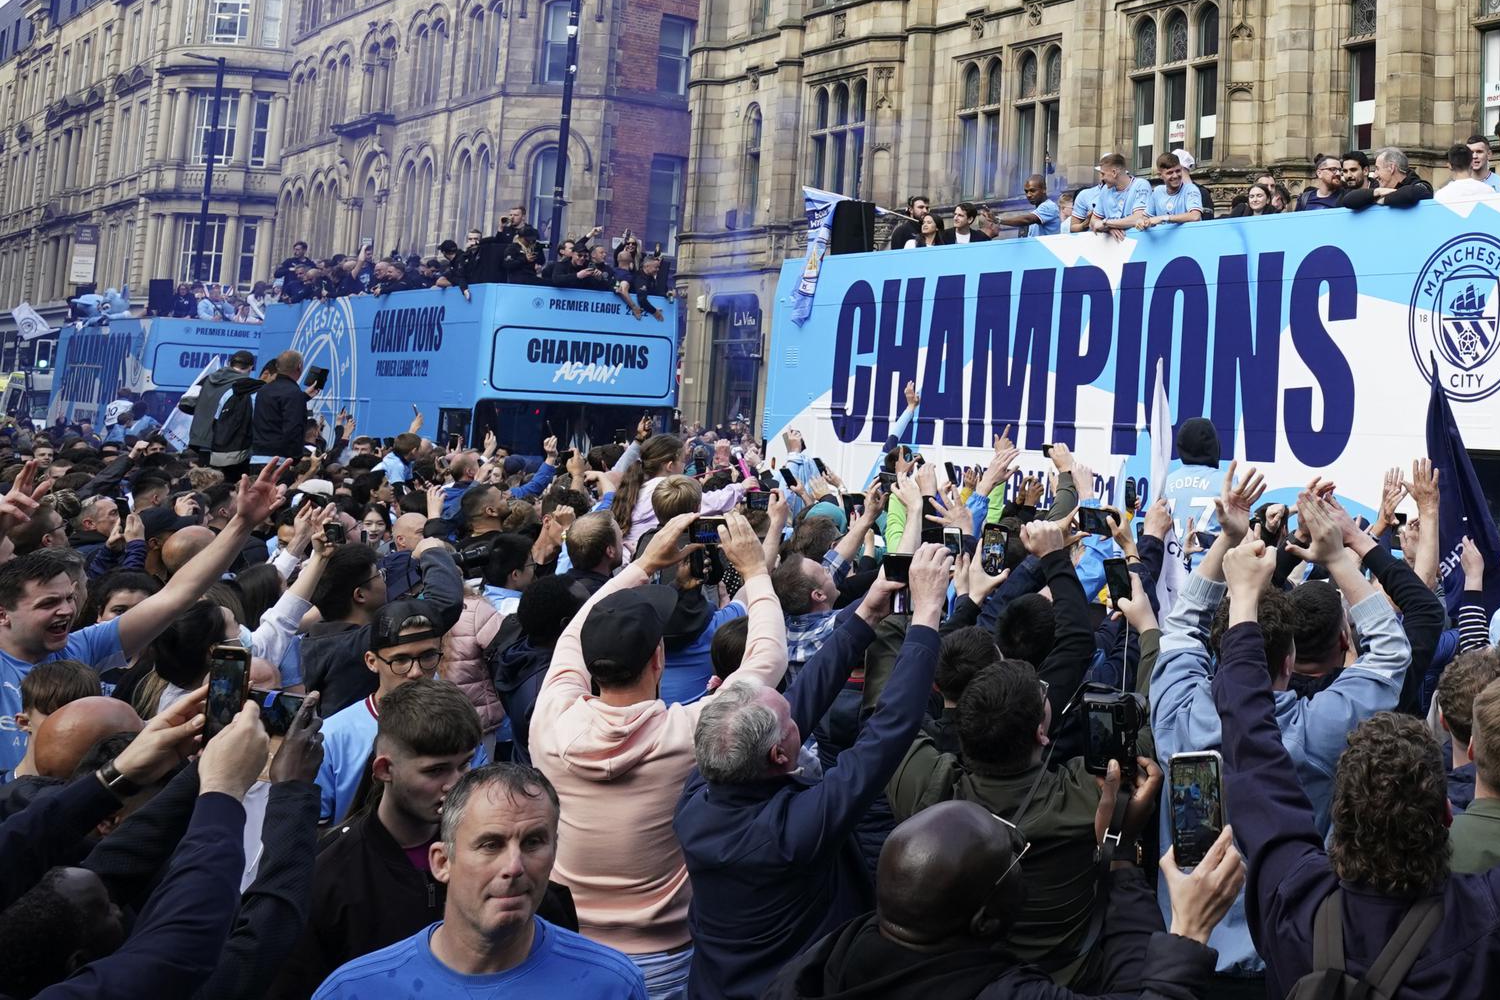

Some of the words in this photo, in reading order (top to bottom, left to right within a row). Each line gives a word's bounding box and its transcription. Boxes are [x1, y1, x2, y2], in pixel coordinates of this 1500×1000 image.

[549, 298, 589, 313] PREMIER
[591, 300, 621, 315] LEAGUE
[371, 305, 446, 353] CHAMPIONS
[1419, 314, 1428, 323] 18
[195, 327, 225, 337] PREMIER
[226, 328, 250, 338] LEAGUE
[527, 337, 649, 370] CHAMPIONS
[831, 245, 1358, 468] CHAMPIONS
[552, 360, 624, 385] AGAIN!
[1450, 373, 1485, 388] CITY
